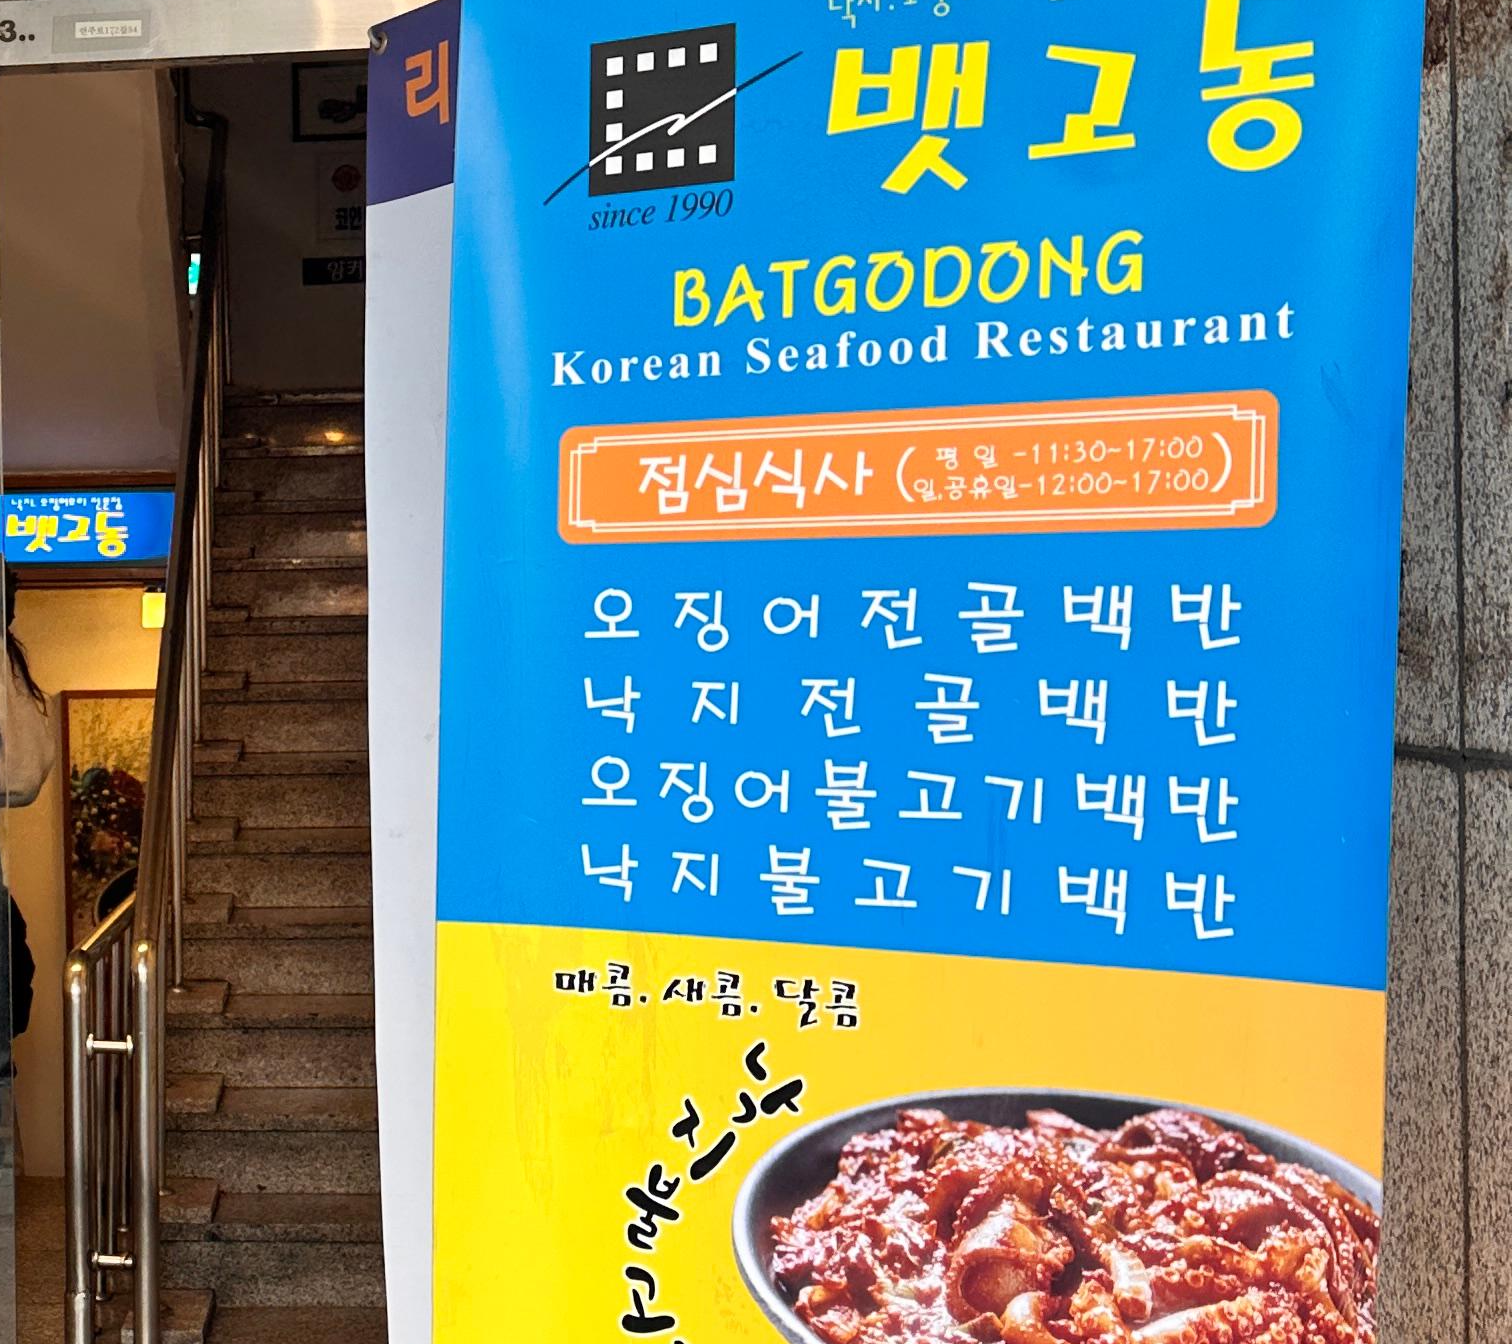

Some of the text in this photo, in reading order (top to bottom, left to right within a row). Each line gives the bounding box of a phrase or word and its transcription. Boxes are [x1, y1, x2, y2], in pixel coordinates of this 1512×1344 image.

[589, 187, 734, 231] since 1990
[673, 229, 1144, 328] BATGODONG
[552, 300, 1296, 387] Korean Seafood Restaurant
[637, 448, 874, 514] 점심식사
[5, 511, 130, 558] 뱃고동
[775, 978, 858, 1029] 달콤
